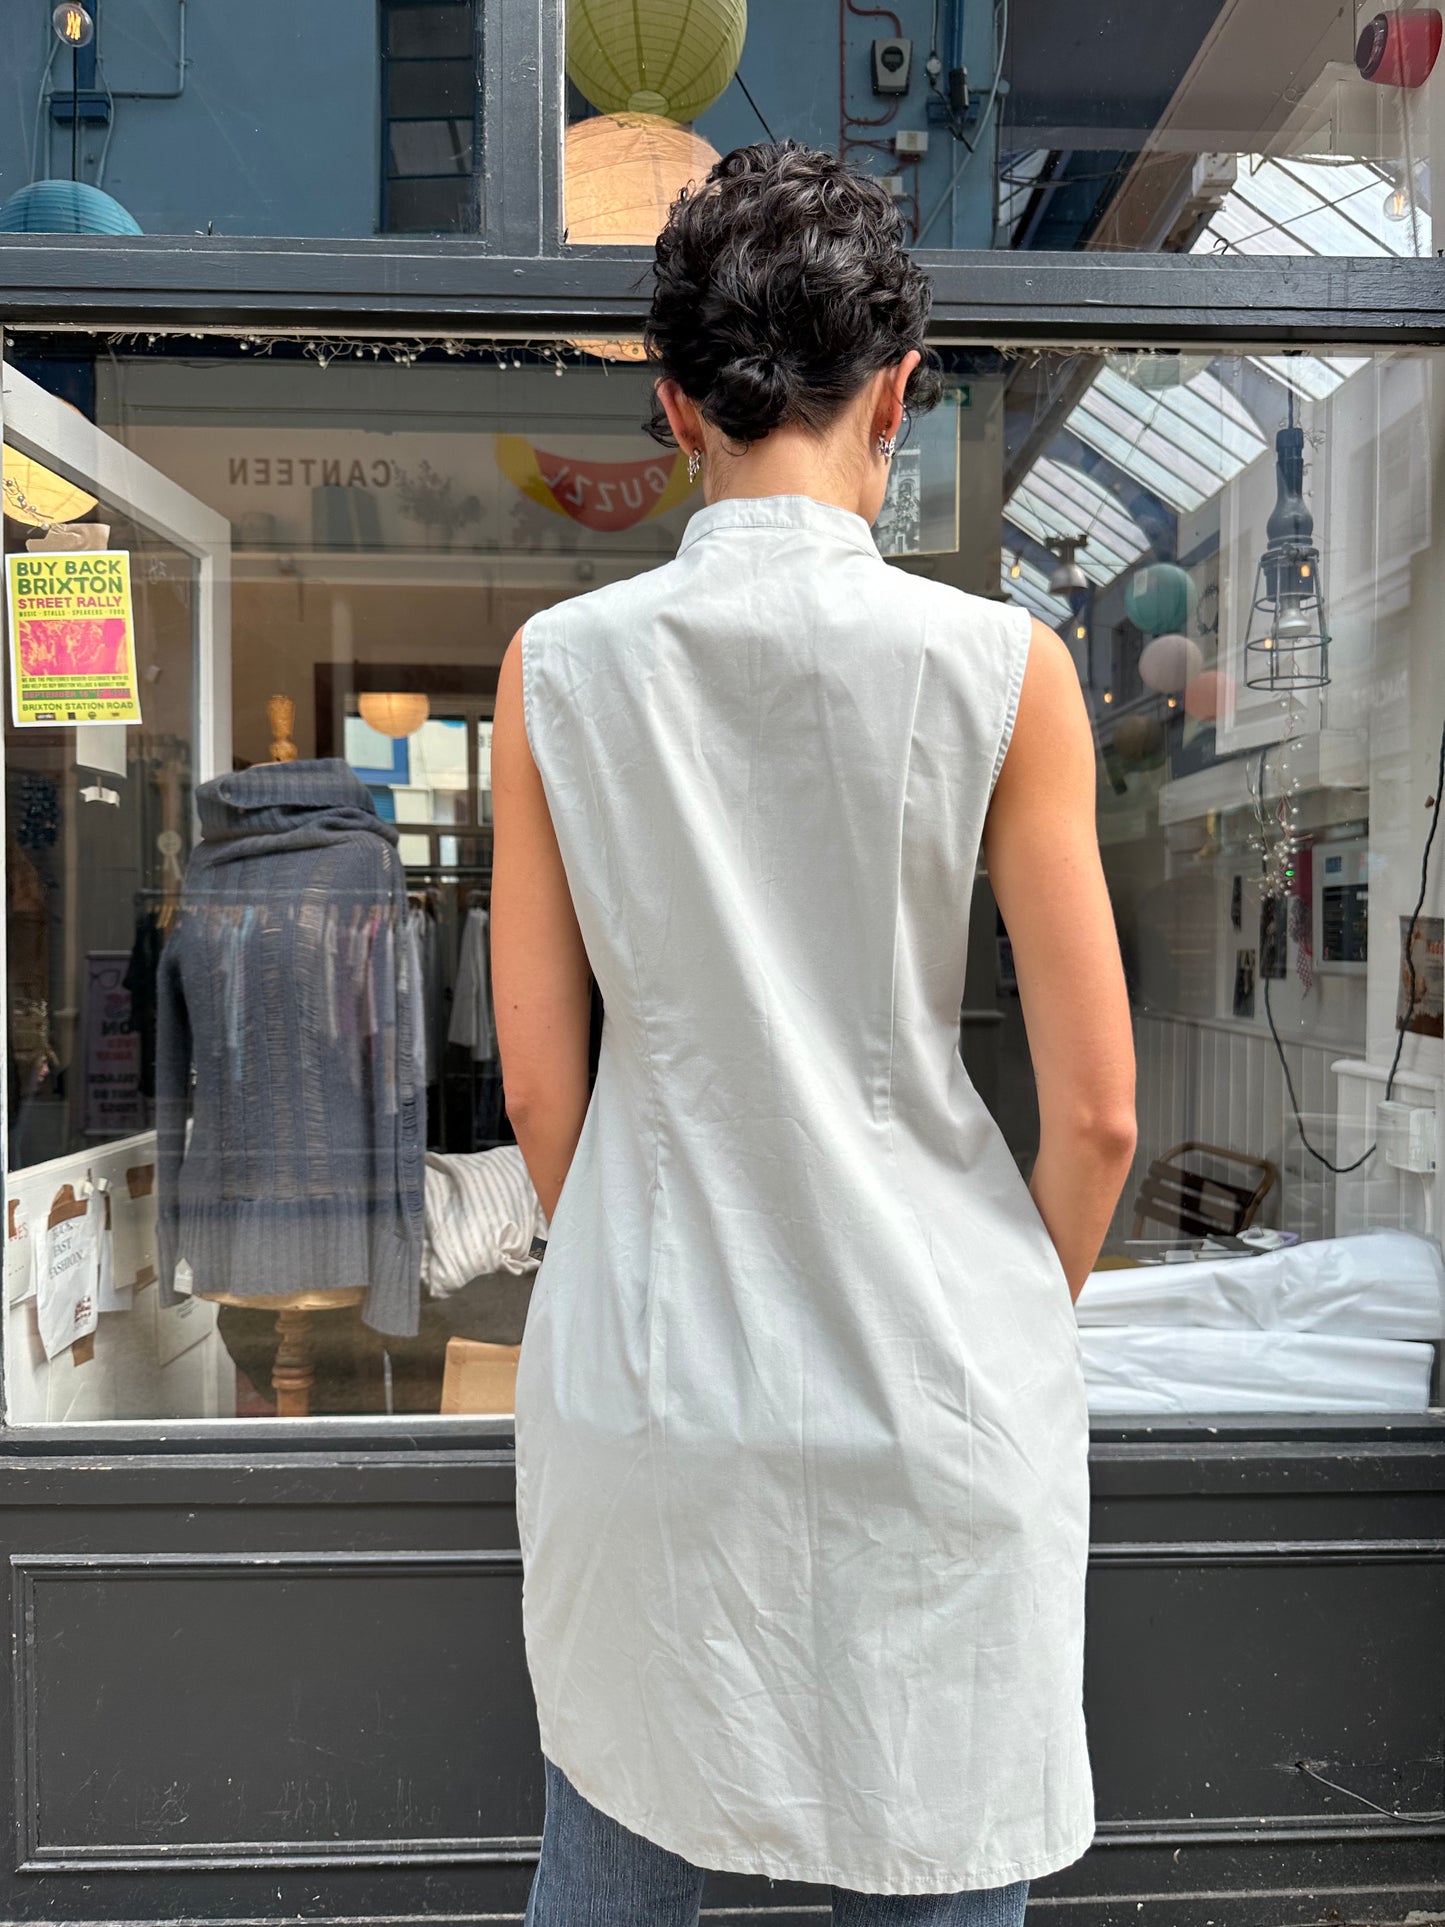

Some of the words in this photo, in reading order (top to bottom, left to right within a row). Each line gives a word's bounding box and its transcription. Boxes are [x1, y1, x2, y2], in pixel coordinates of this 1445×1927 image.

[16, 561, 58, 577] BUY
[65, 559, 121, 575] BACK
[18, 576, 123, 595] BRIXTON
[18, 597, 72, 609] STREET
[77, 595, 122, 608] RALLY
[24, 690, 75, 699] SEPTEMBER
[22, 703, 62, 711] BRIXTON
[65, 702, 104, 710] STATION
[107, 701, 133, 709] ROAD
